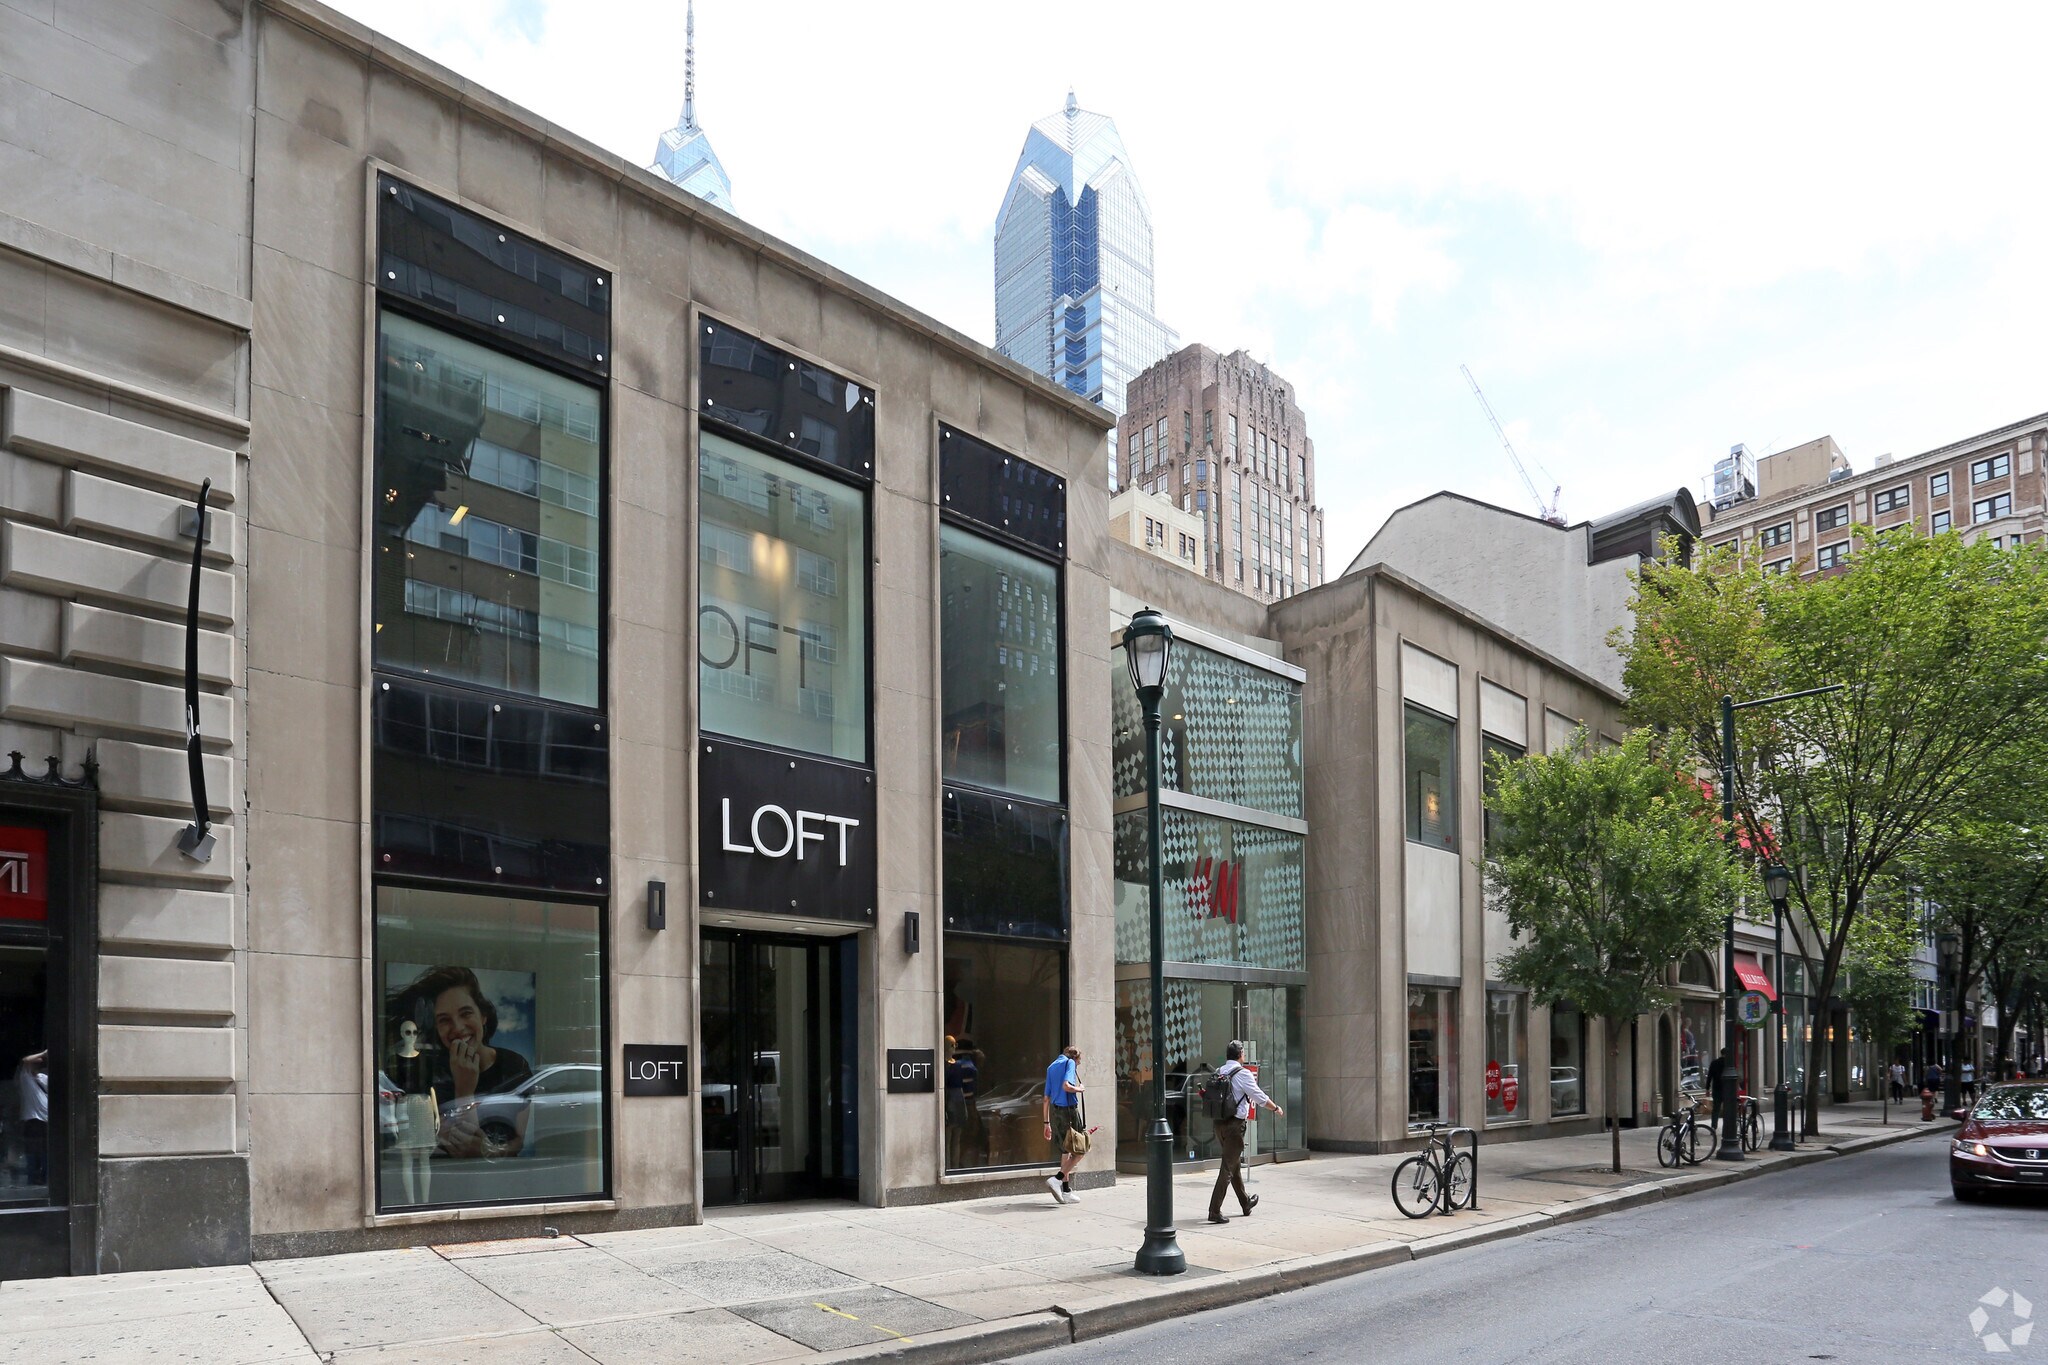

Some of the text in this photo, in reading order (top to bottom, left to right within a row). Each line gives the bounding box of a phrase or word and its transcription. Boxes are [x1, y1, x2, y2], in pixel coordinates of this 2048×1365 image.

[722, 797, 860, 867] LOFT
[1740, 973, 1767, 986] TALBOTS
[629, 1060, 683, 1080] LOFT
[891, 1062, 931, 1080] LOFT
